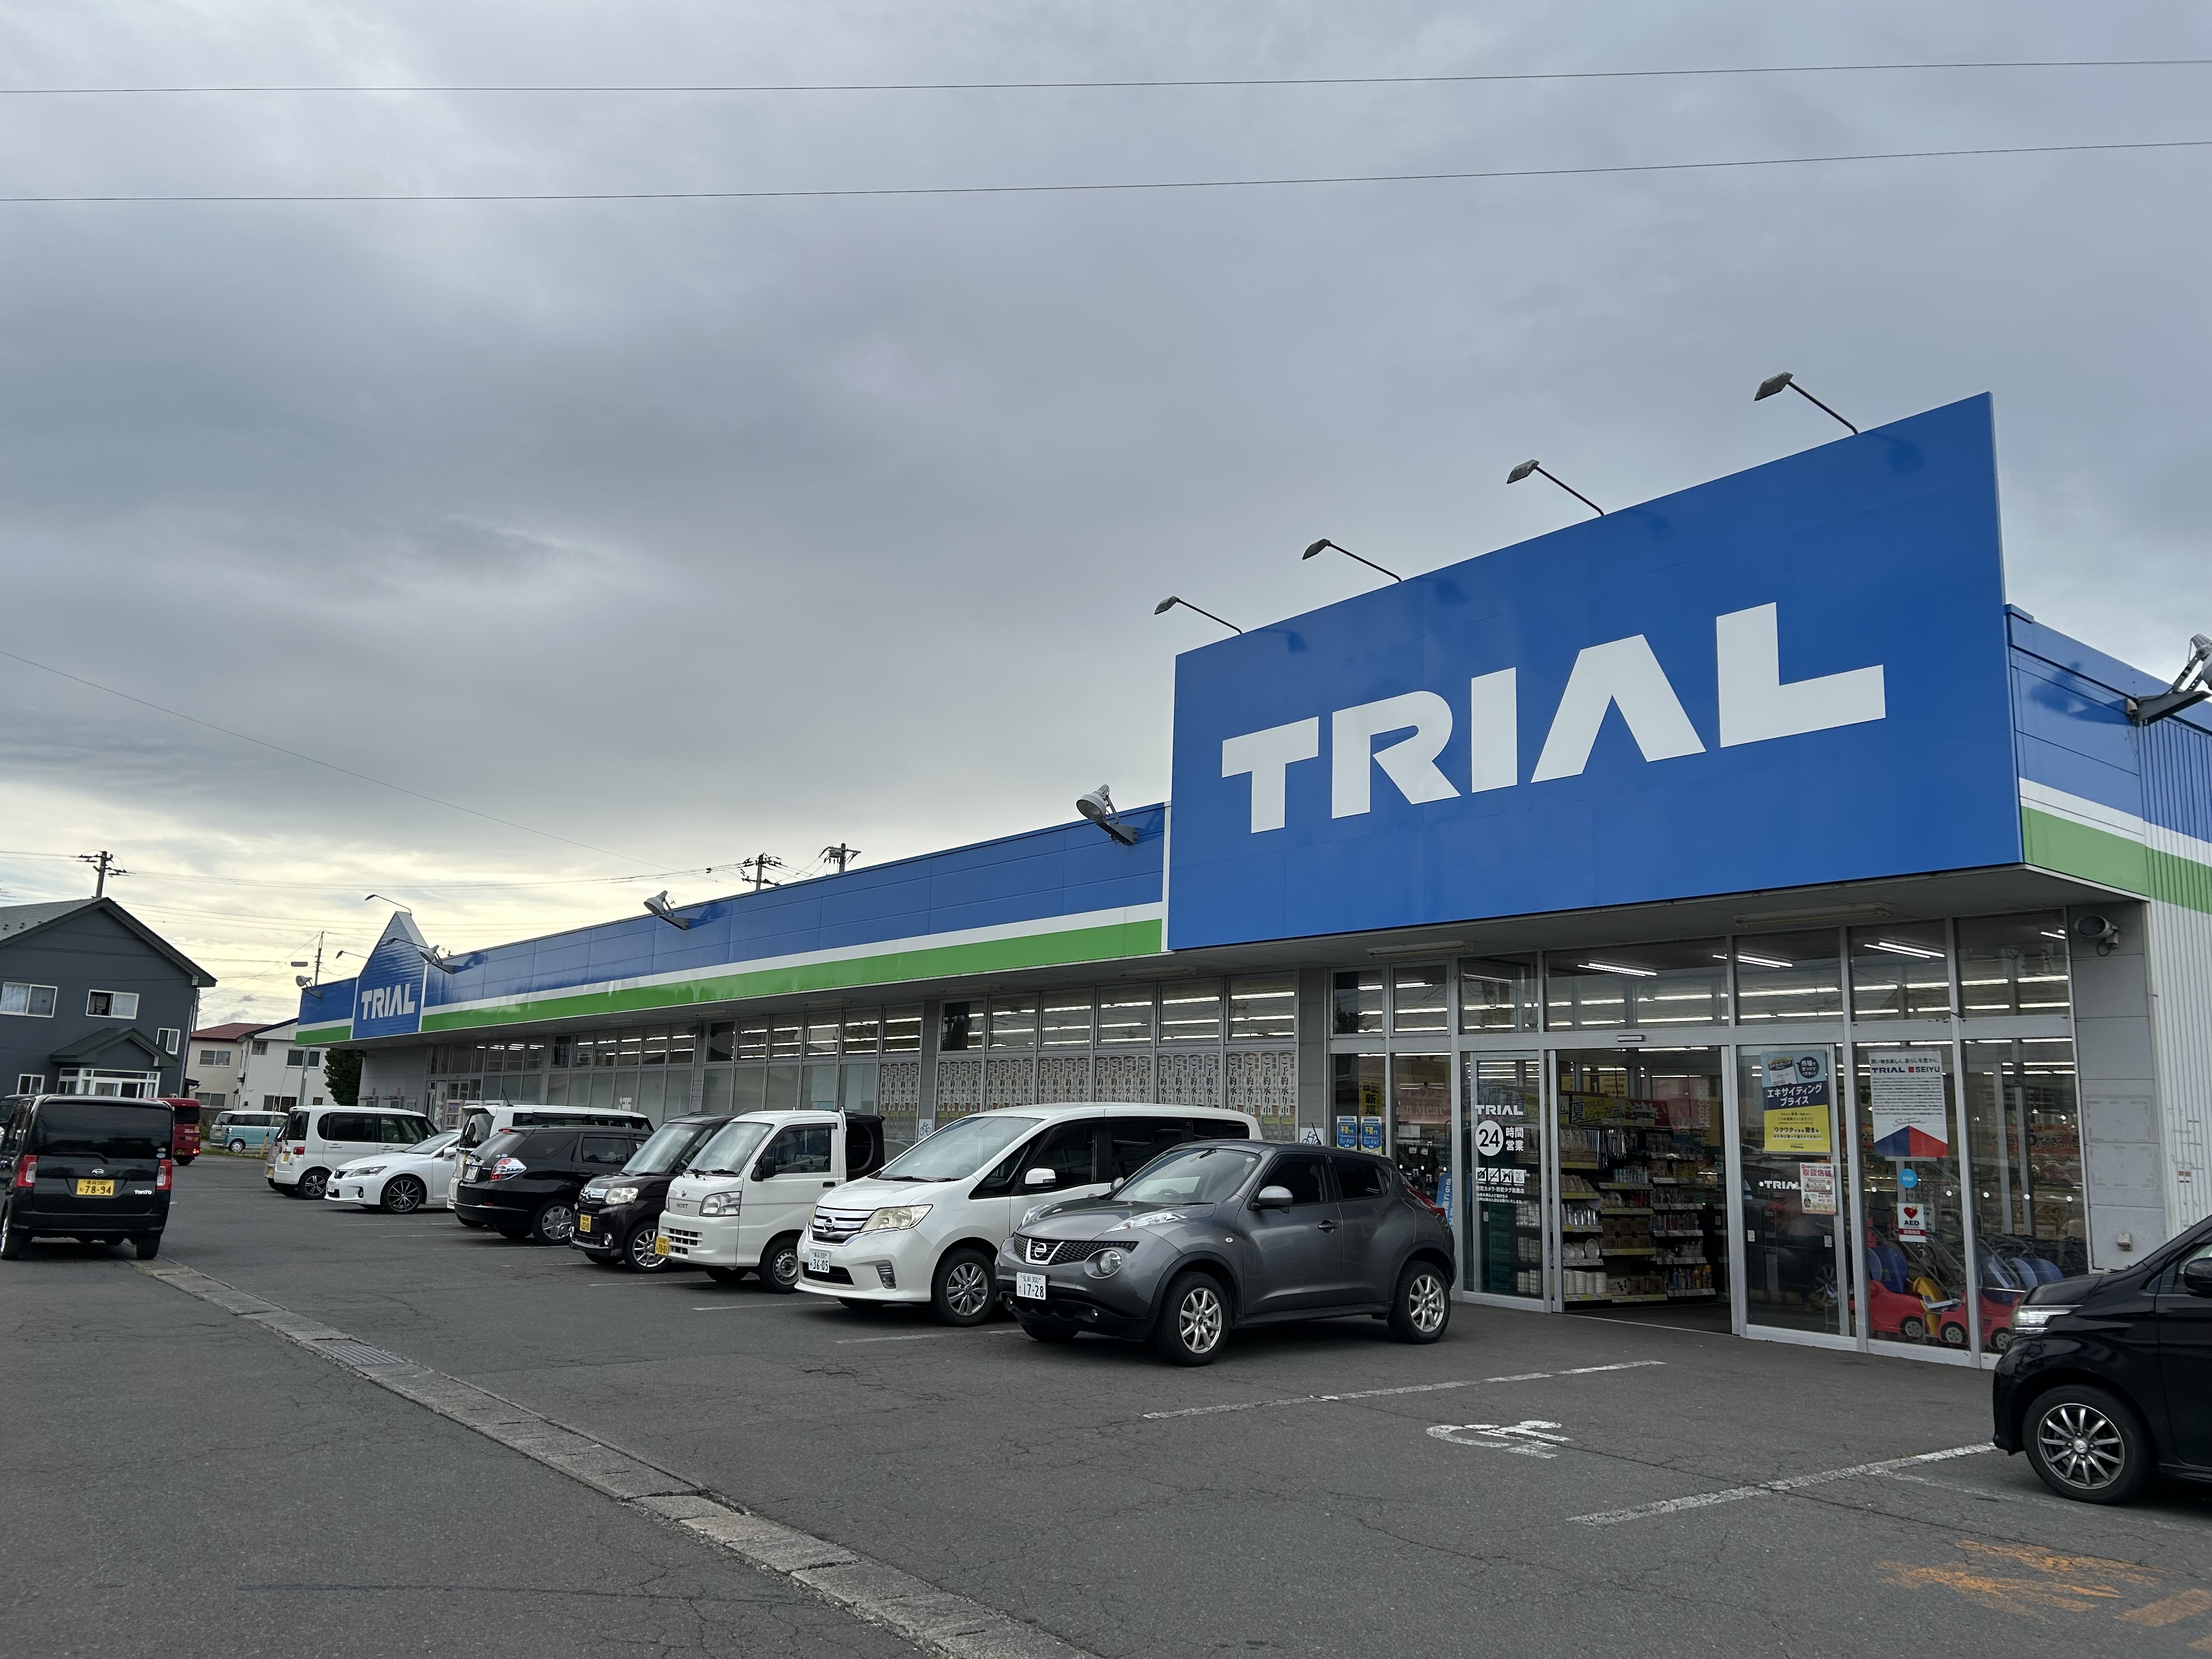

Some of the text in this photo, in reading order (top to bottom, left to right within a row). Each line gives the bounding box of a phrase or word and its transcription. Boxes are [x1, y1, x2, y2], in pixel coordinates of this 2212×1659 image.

[1222, 602, 1886, 834] TRIAL
[361, 983, 415, 1020] TRIAL
[1767, 1083, 1822, 1098] エキサイティング
[1780, 1096, 1809, 1107] プライス
[1475, 1104, 1523, 1115] TRIAL
[1479, 1126, 1524, 1147] 24 時間
[1505, 1139, 1524, 1152] 営業
[85, 1186, 111, 1194] 78-94
[1764, 1180, 1801, 1190] TRIAL
[1024, 1283, 1044, 1298] 17-28
